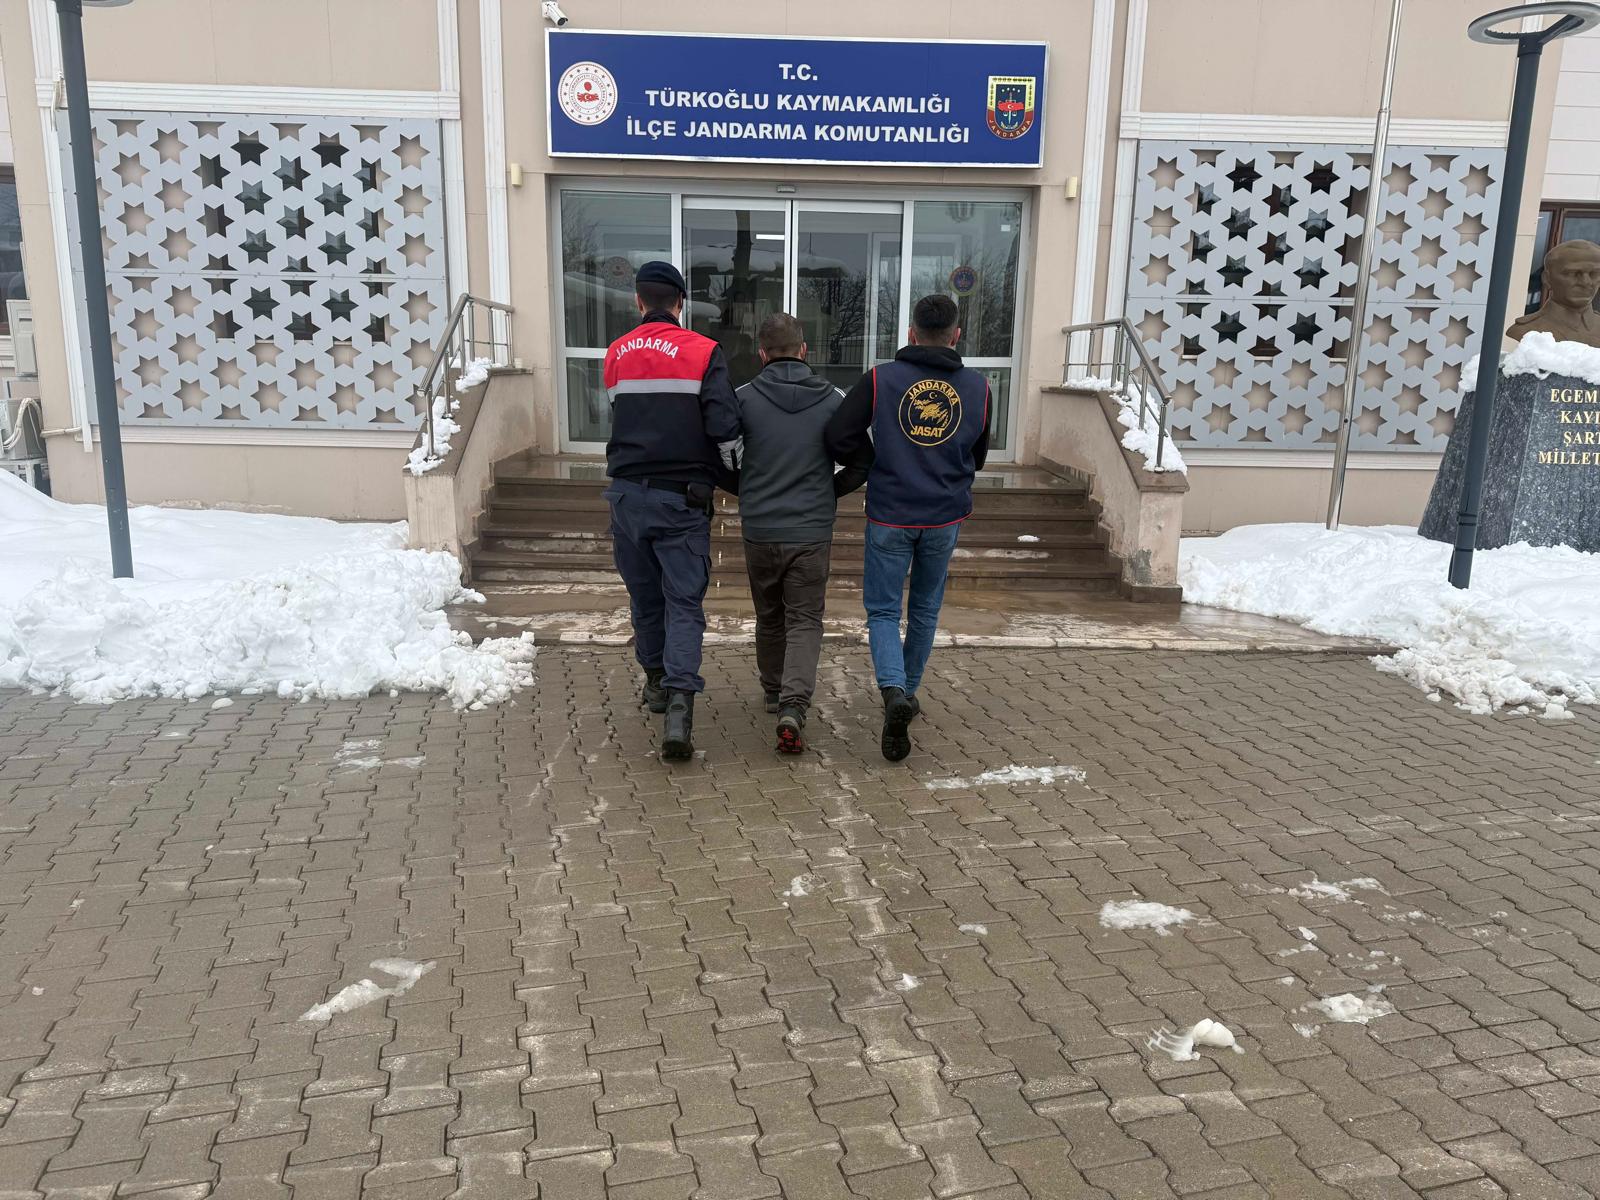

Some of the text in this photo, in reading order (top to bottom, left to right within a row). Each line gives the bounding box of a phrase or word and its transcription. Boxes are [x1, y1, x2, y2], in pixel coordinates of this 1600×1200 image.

[778, 63, 818, 81] T.C.
[644, 87, 950, 114] TÜRKOĞLU KAYMAKAMLIĞI
[626, 115, 970, 143] İLÇE JANDARMA KOMUTANLIĞI
[989, 119, 1031, 137] JANDARMA
[615, 336, 679, 360] JANDARMA
[908, 381, 959, 405] JANDARMA
[1550, 388, 1598, 404] EGEM
[910, 425, 945, 438] JASAT
